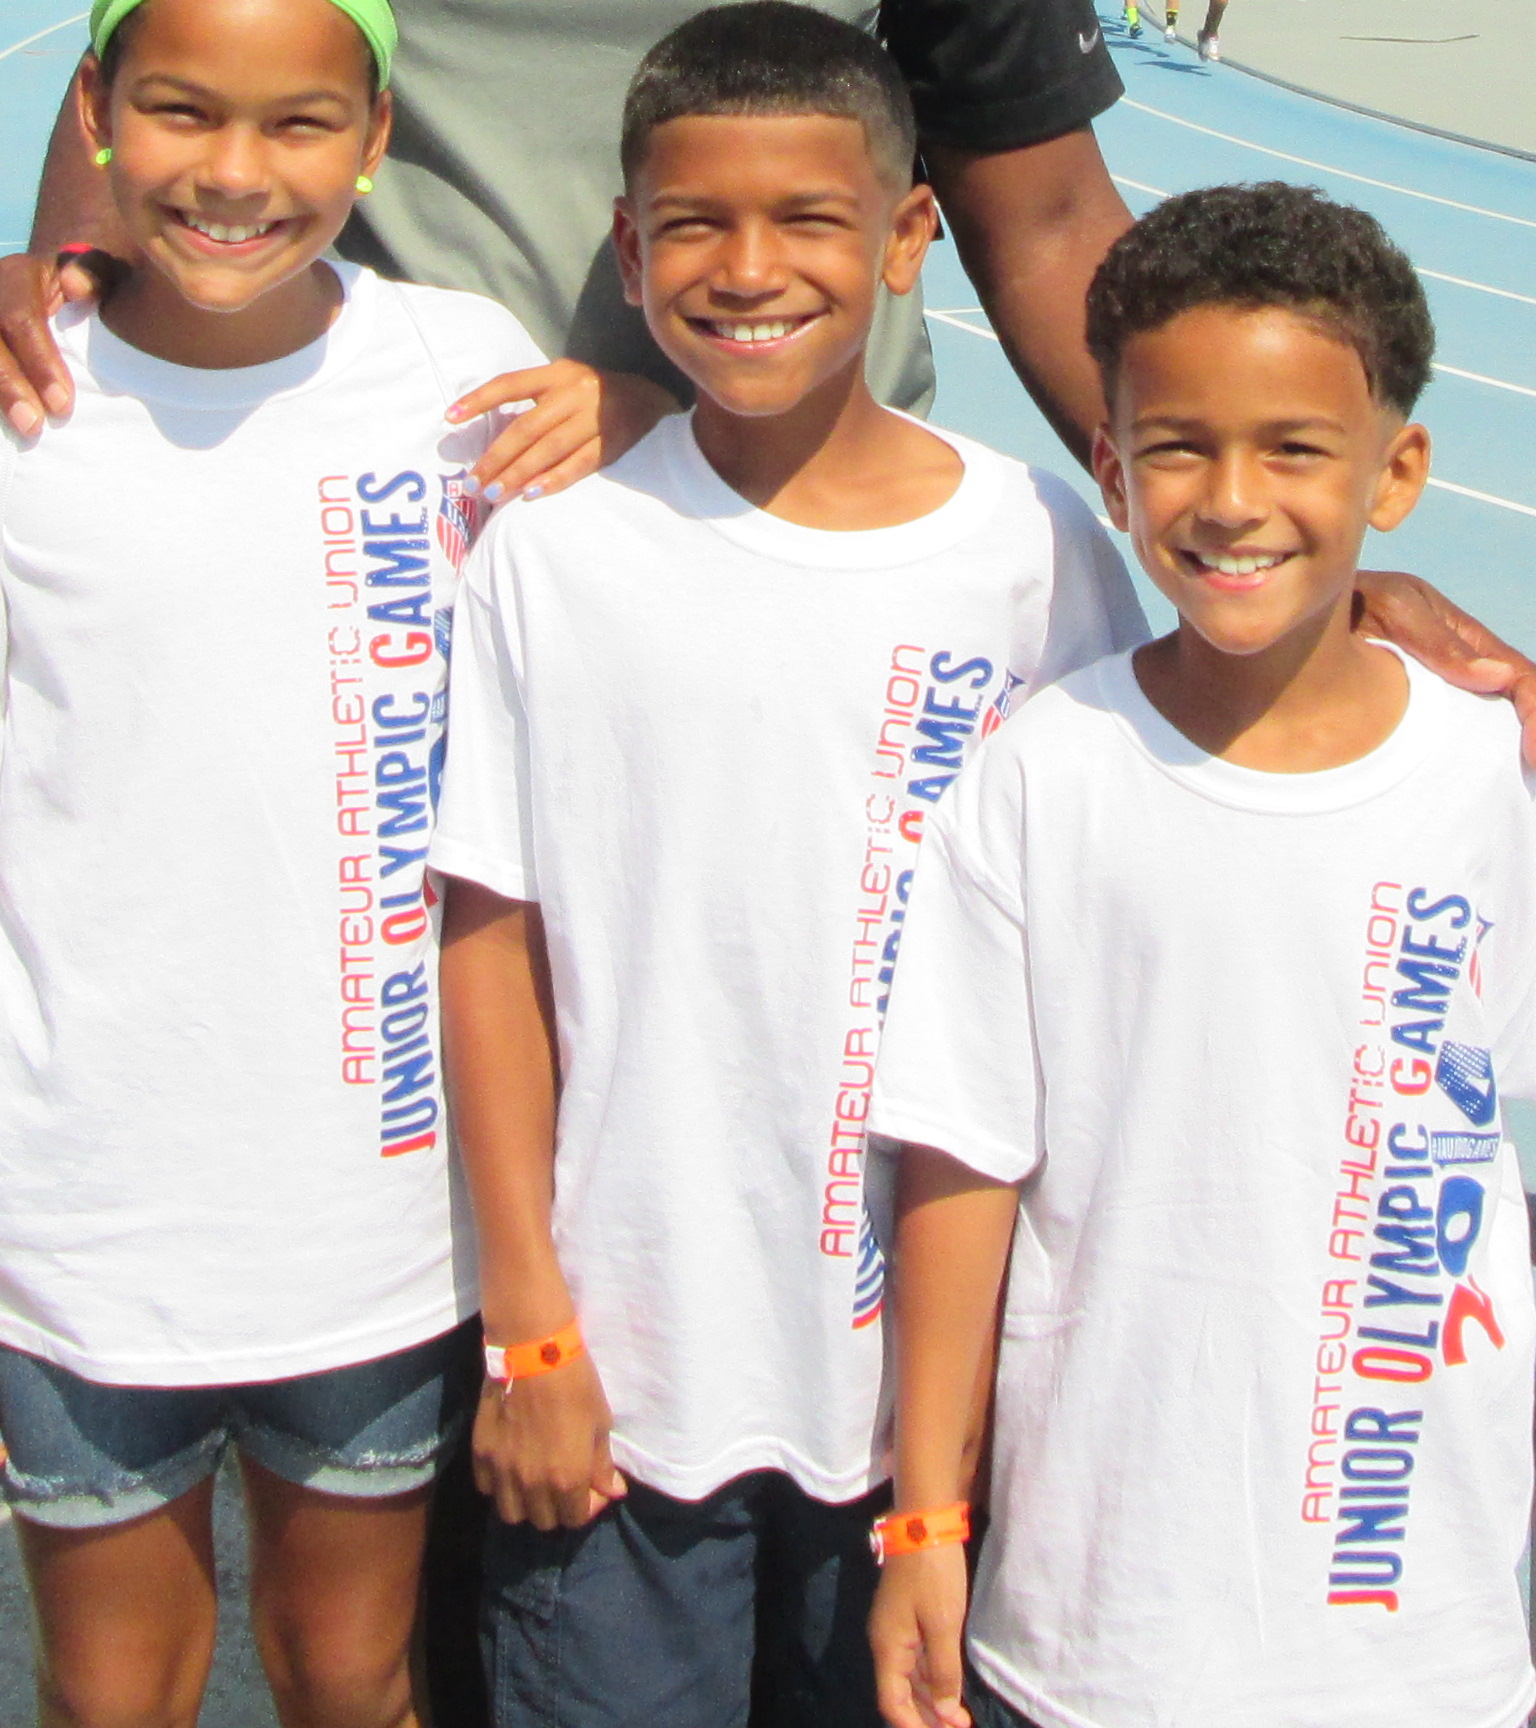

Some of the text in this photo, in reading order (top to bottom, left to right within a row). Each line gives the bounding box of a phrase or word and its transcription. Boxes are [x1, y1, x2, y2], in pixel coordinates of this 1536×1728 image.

[358, 469, 436, 1160] JUNIOR OLYMPIC GAMES
[1326, 884, 1471, 1613] JUNIOR OLYMPIC GAMES
